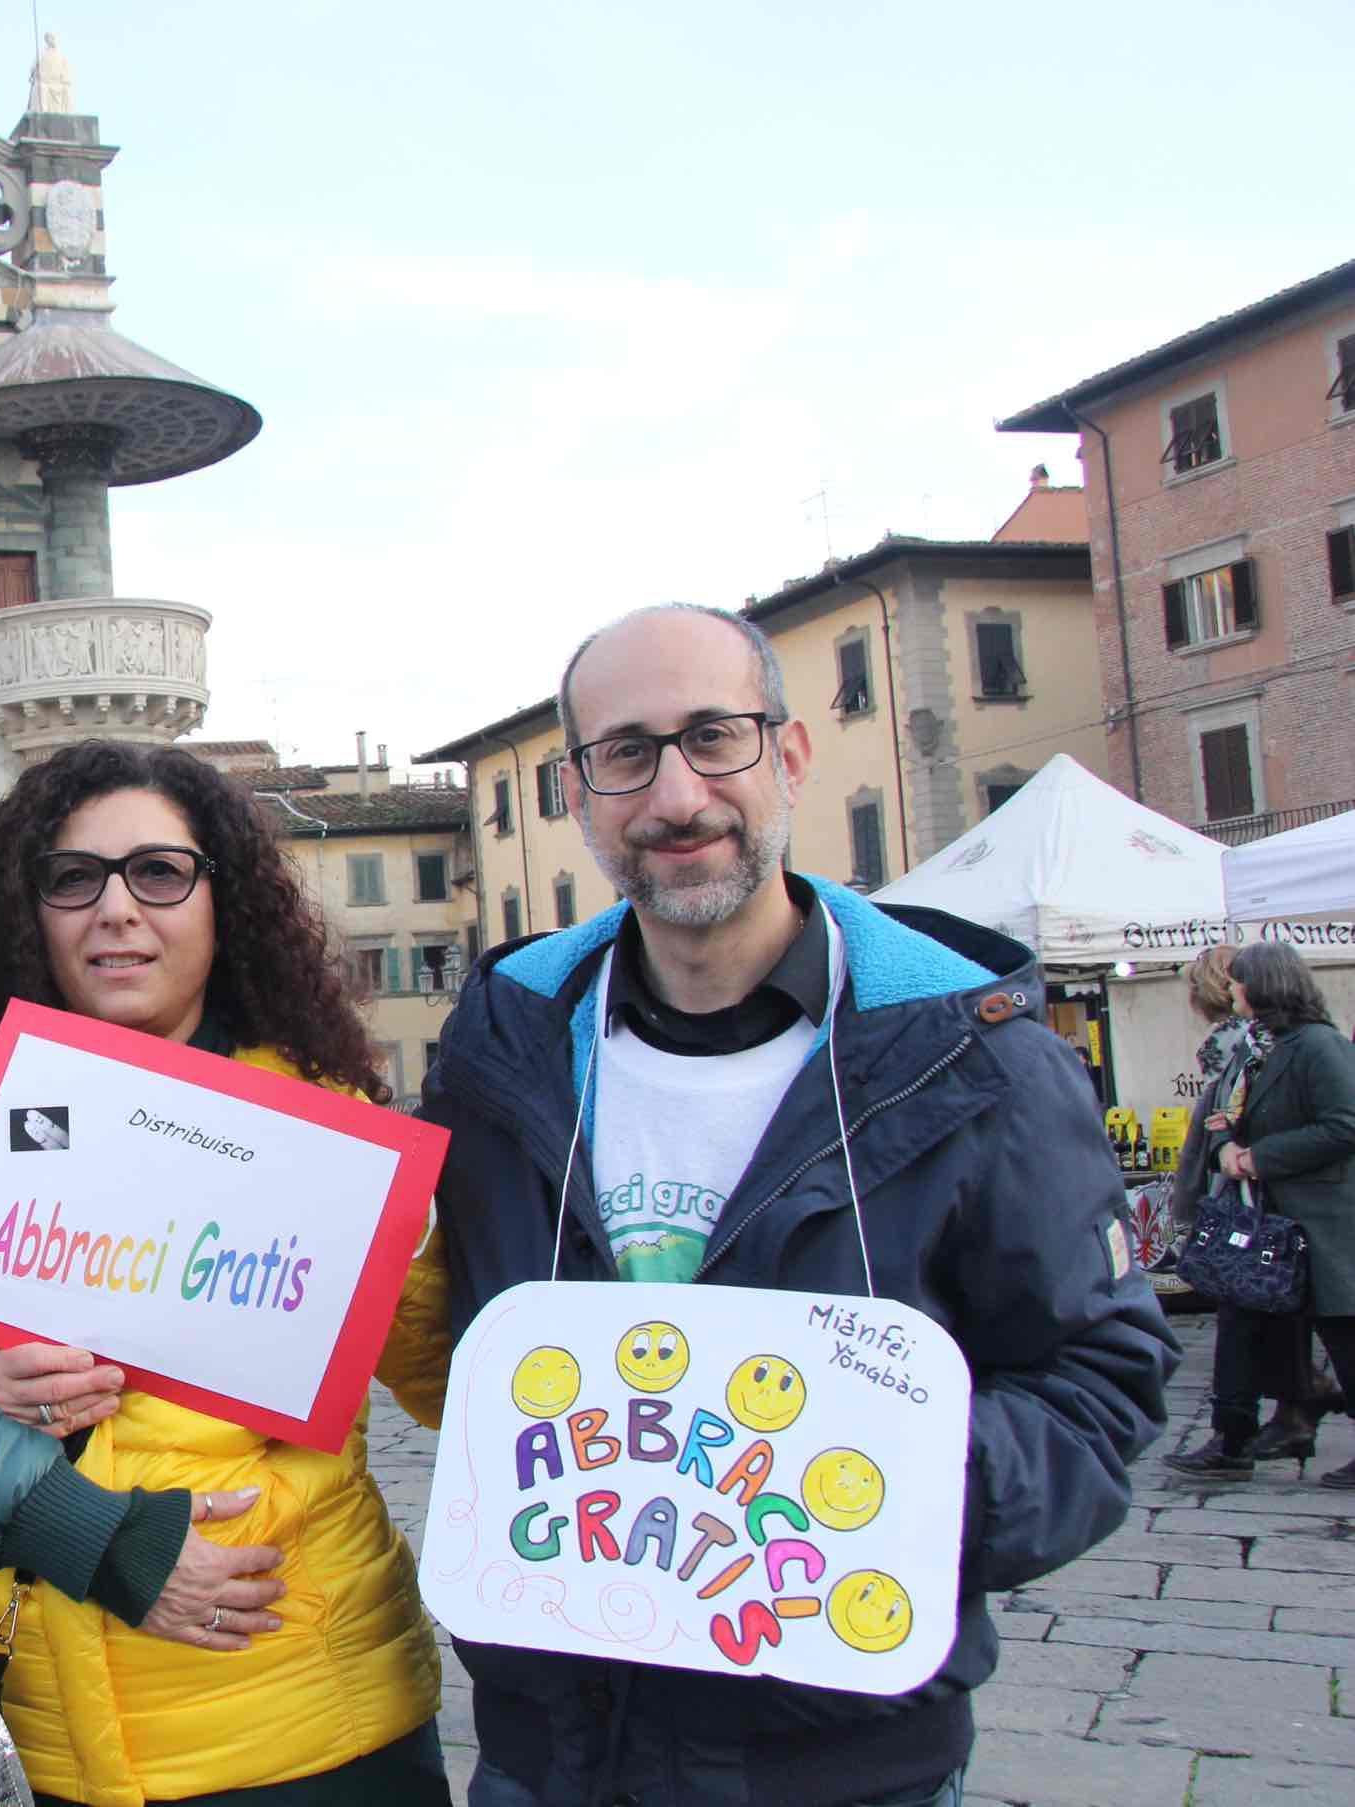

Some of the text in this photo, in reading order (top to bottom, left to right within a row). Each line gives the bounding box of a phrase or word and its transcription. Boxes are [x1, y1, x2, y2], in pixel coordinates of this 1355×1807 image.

[127, 1108, 255, 1163] Distribuisco
[180, 1221, 313, 1313] Gratis
[514, 1397, 827, 1619] ABBRACCI
[509, 1489, 783, 1667] GRATIS
